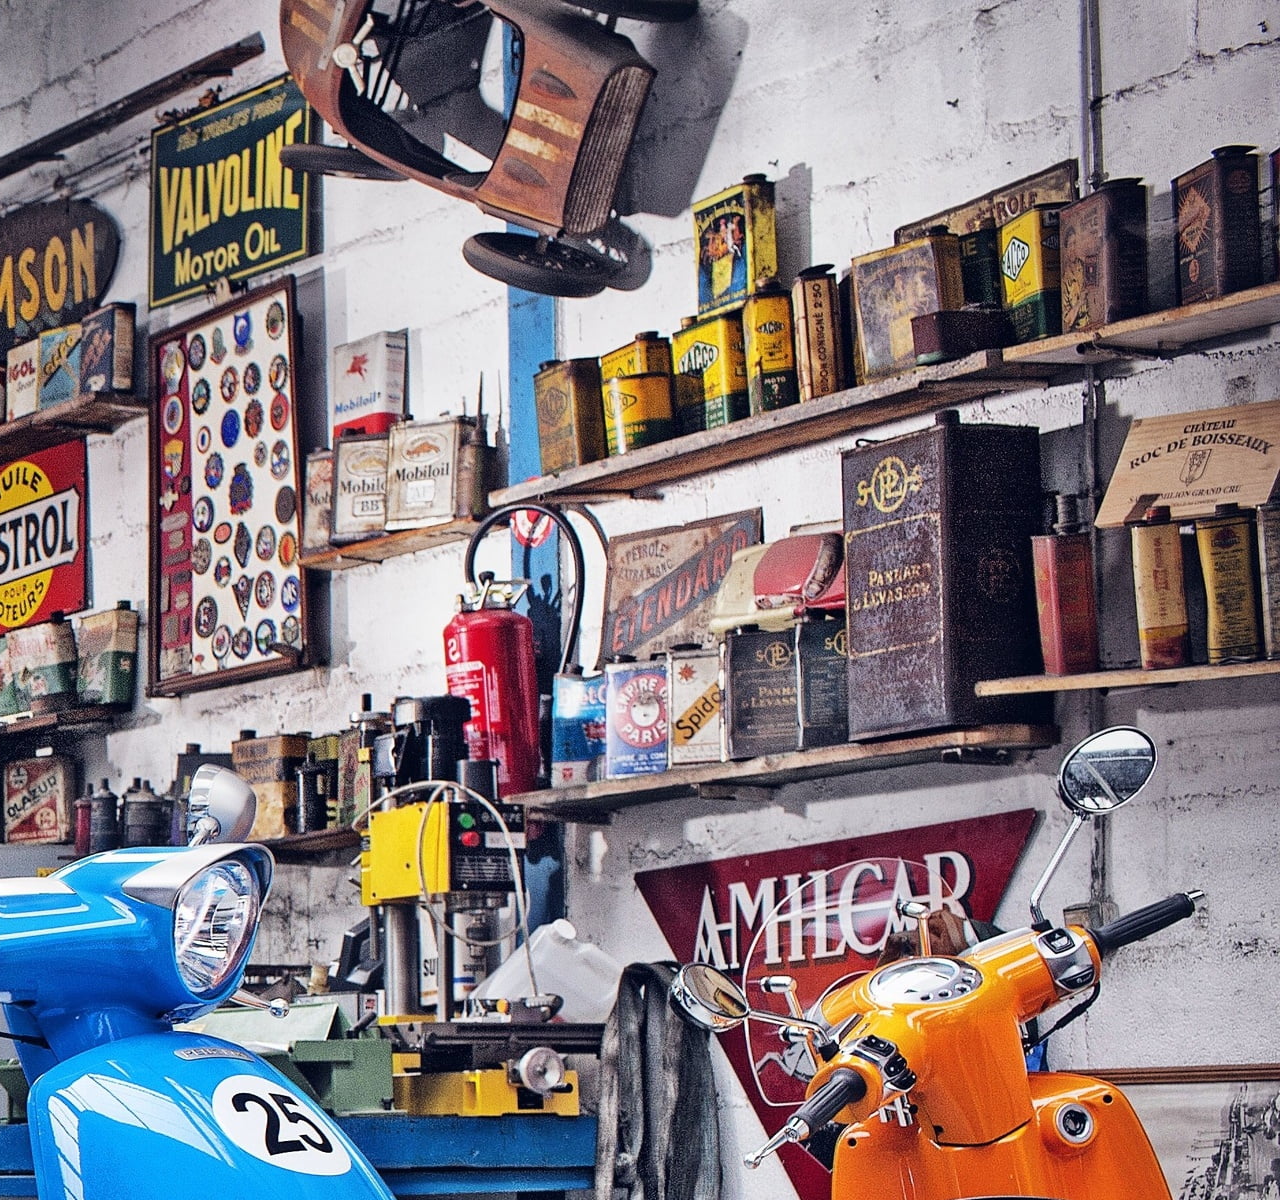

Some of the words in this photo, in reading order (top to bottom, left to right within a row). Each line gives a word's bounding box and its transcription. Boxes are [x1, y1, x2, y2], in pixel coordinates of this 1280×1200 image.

[159, 108, 303, 256] VALVOLINE
[174, 242, 240, 287] MOTOR
[244, 221, 282, 261] OIL
[334, 390, 378, 415] Mobiloil
[1182, 419, 1238, 435] CHÂTEAU
[1129, 446, 1163, 470] ROC
[1166, 437, 1189, 454] DE
[1191, 432, 1274, 456] BOISSEAUX
[394, 462, 451, 483] Mobiloil
[339, 477, 387, 497] Mobil
[1191, 486, 1222, 498] GRAND
[1223, 484, 1242, 495] CRU
[360, 500, 380, 513] BB
[3, 583, 28, 599] POUR
[758, 686, 798, 698] PANHA
[621, 718, 667, 744] PARIS
[231, 1092, 334, 1156] 25
